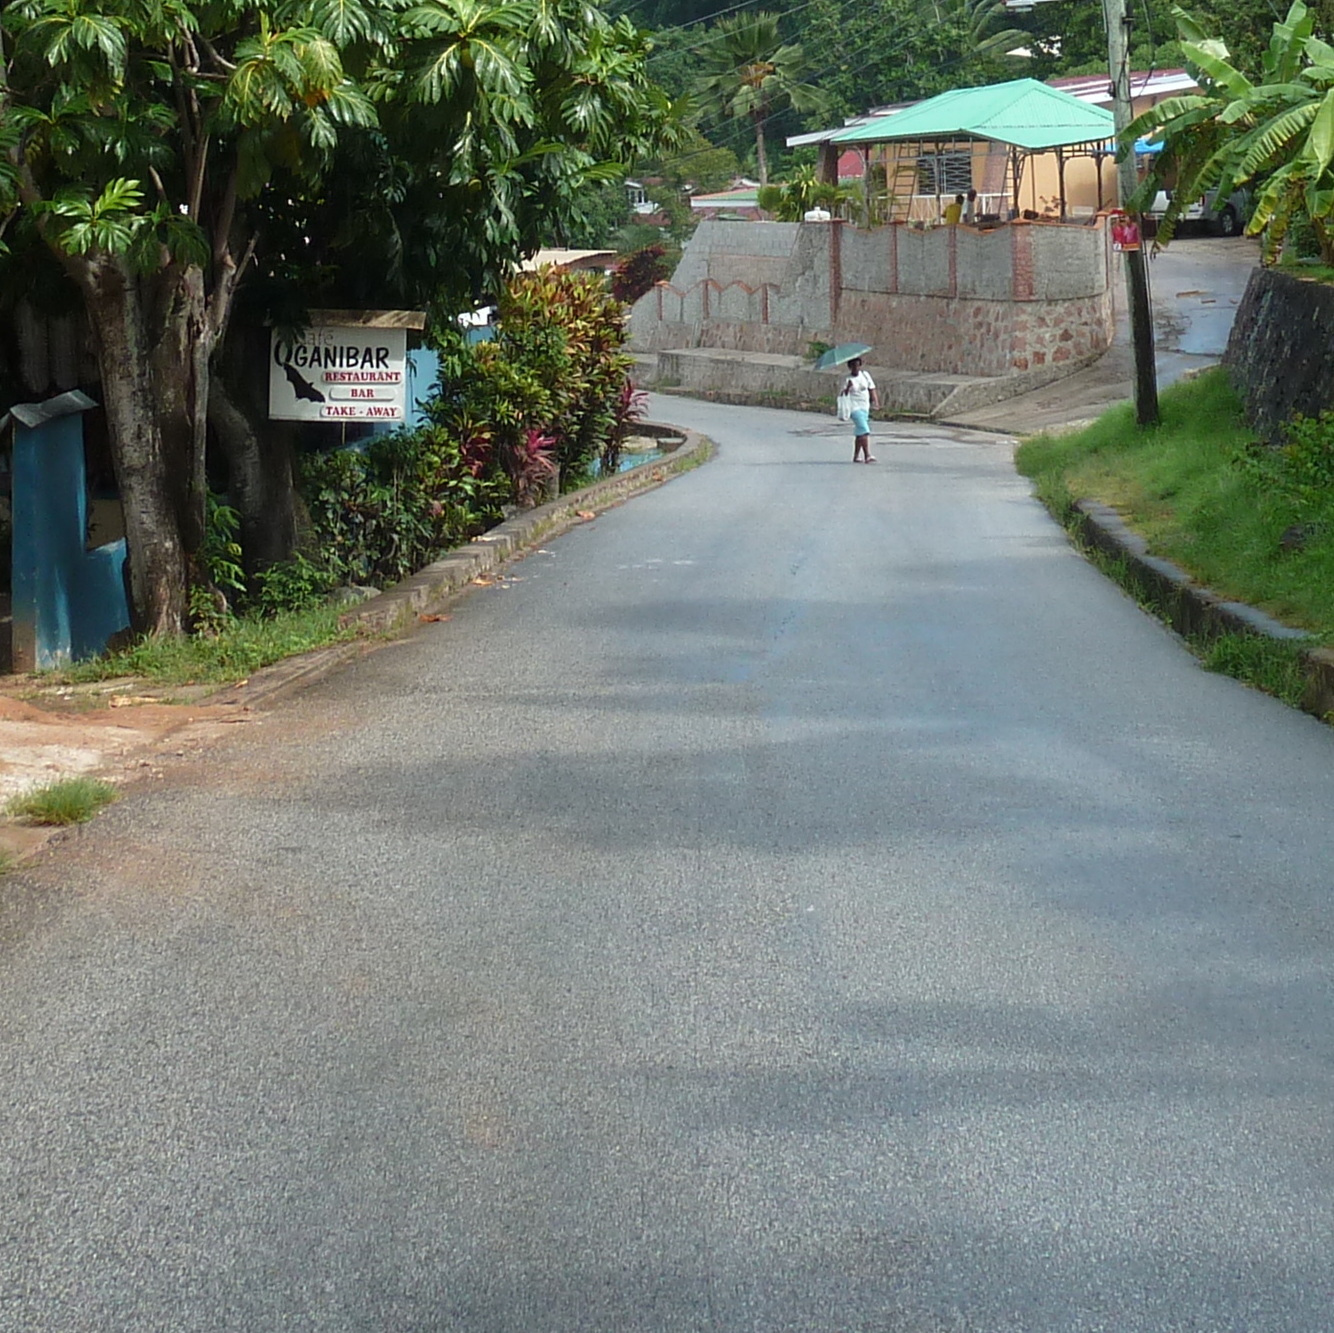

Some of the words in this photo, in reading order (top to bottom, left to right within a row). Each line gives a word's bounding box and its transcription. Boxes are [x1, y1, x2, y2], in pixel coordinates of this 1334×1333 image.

[325, 371, 401, 382] RESTAURANT
[350, 388, 374, 398] BAR
[326, 406, 356, 416] TAKE
[366, 407, 398, 417] AWAY
